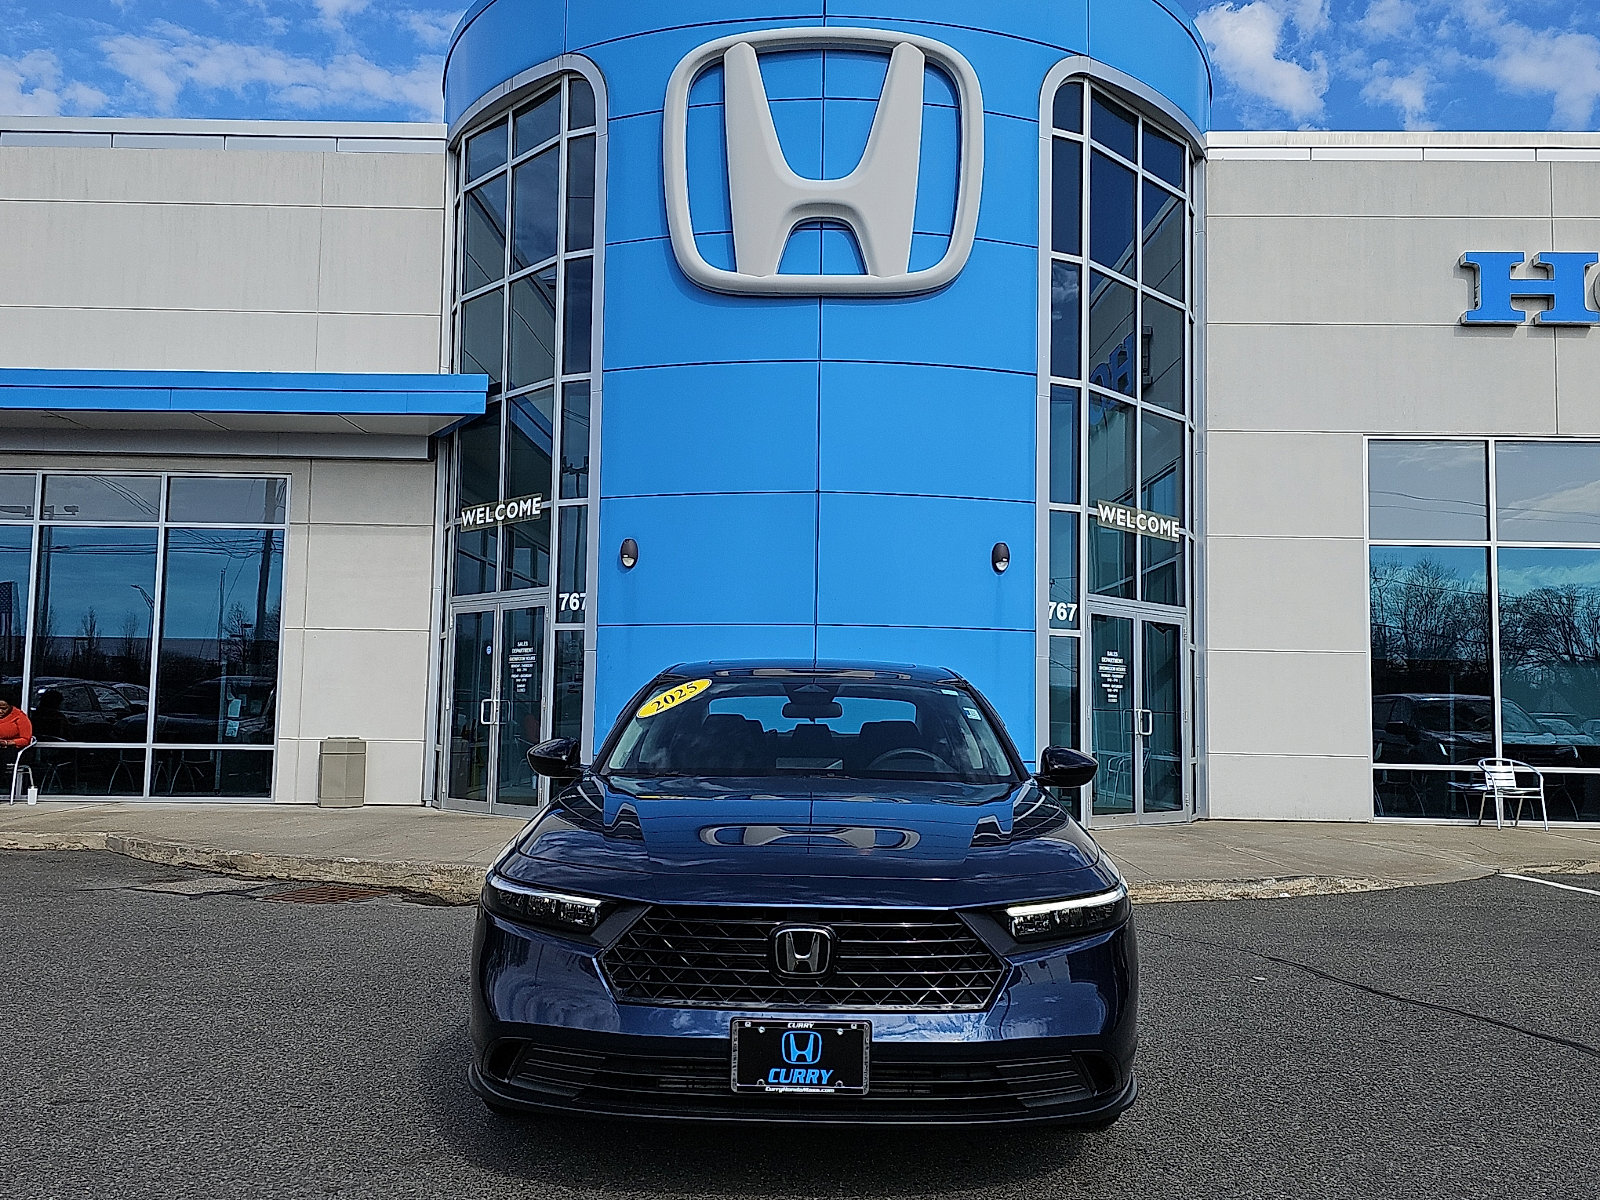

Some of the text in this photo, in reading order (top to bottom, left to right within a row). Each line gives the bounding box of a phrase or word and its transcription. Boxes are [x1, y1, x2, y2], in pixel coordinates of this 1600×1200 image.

[1460, 251, 1600, 324] H
[461, 497, 542, 527] WELCOME
[1098, 503, 1180, 539] WELCOME
[559, 592, 587, 611] 767
[1048, 601, 1078, 622] 767
[651, 683, 698, 711] 2025
[768, 1068, 834, 1085] CURRY
